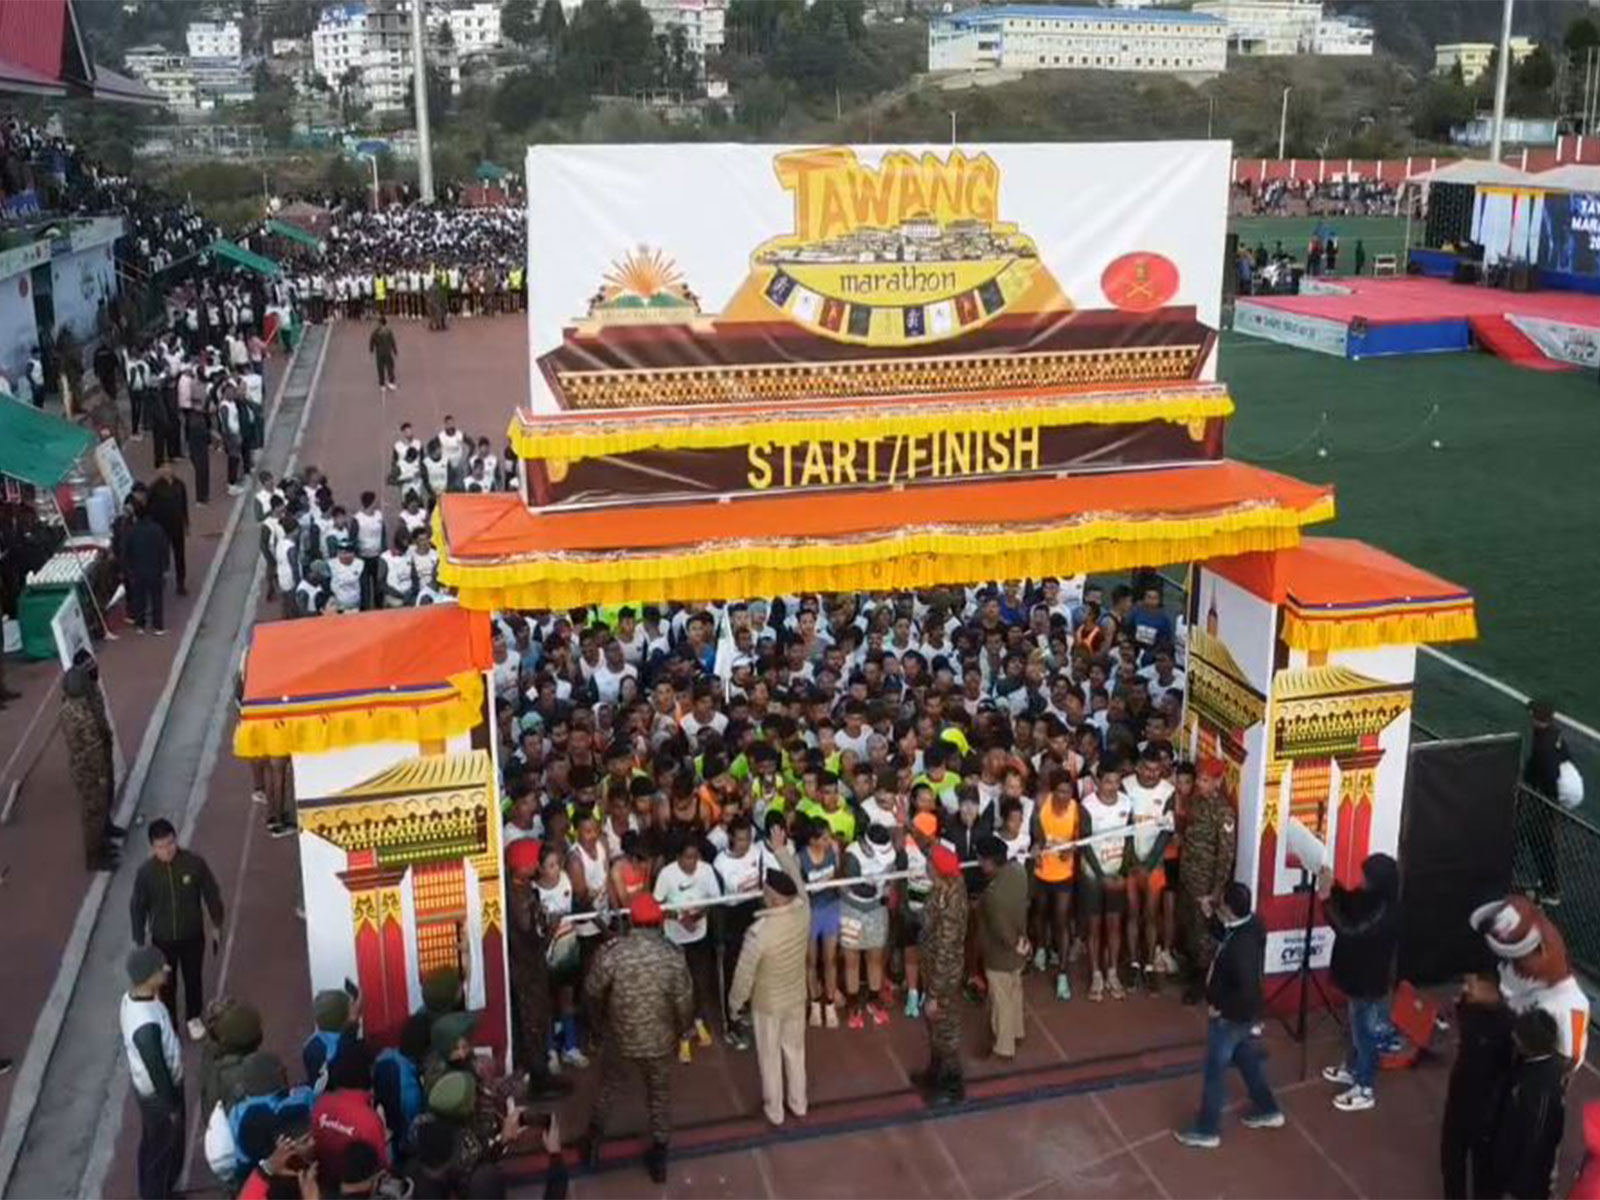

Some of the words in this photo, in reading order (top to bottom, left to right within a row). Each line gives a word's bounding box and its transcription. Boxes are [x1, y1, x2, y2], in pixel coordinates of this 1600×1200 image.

[775, 147, 998, 240] TAWANG
[840, 265, 956, 293] marathon
[747, 426, 1040, 490] START/FINISH
